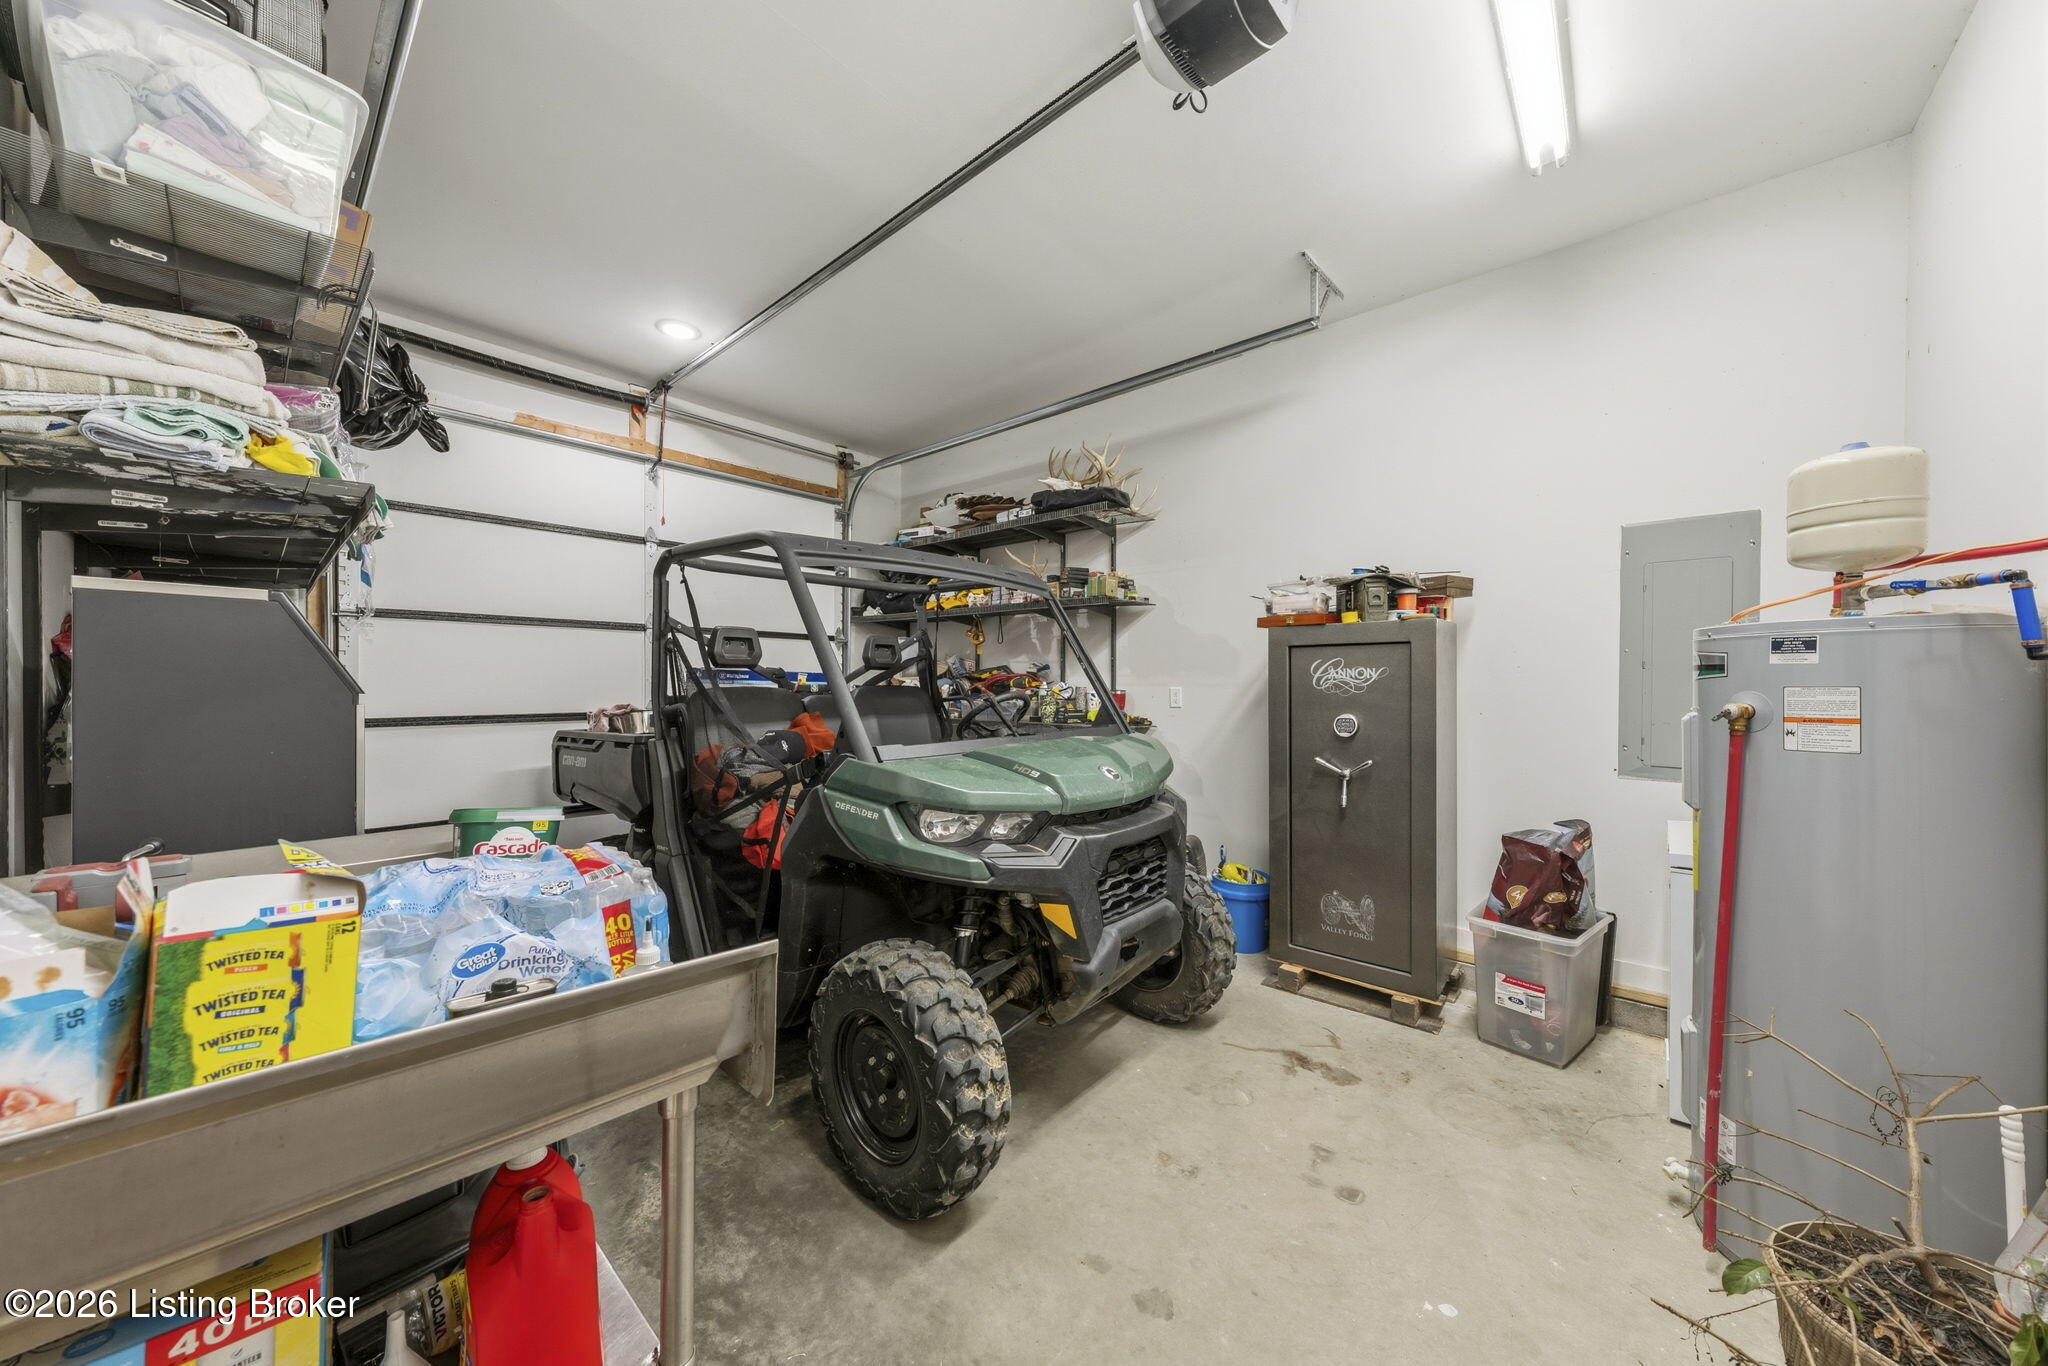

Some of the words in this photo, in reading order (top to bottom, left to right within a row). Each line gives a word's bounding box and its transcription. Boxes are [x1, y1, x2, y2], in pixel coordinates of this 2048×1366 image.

[834, 801, 879, 820] DEFENDER
[341, 920, 357, 934] 12
[605, 913, 632, 932] 40
[1321, 923, 1347, 935] VALLEY
[206, 951, 261, 972] TWISTED
[263, 950, 285, 960] TEA
[456, 946, 498, 970] Great
[467, 956, 498, 972] Value
[498, 952, 566, 971] Drinking
[193, 991, 258, 1016] TWISTED
[261, 989, 287, 1000] TEA
[66, 1007, 86, 1029] 95
[199, 1028, 255, 1052] TWISTED
[257, 1026, 280, 1036] TEA
[202, 1061, 253, 1083] TWISTED
[255, 1059, 275, 1067] TEA
[427, 1283, 448, 1343] VICTOR
